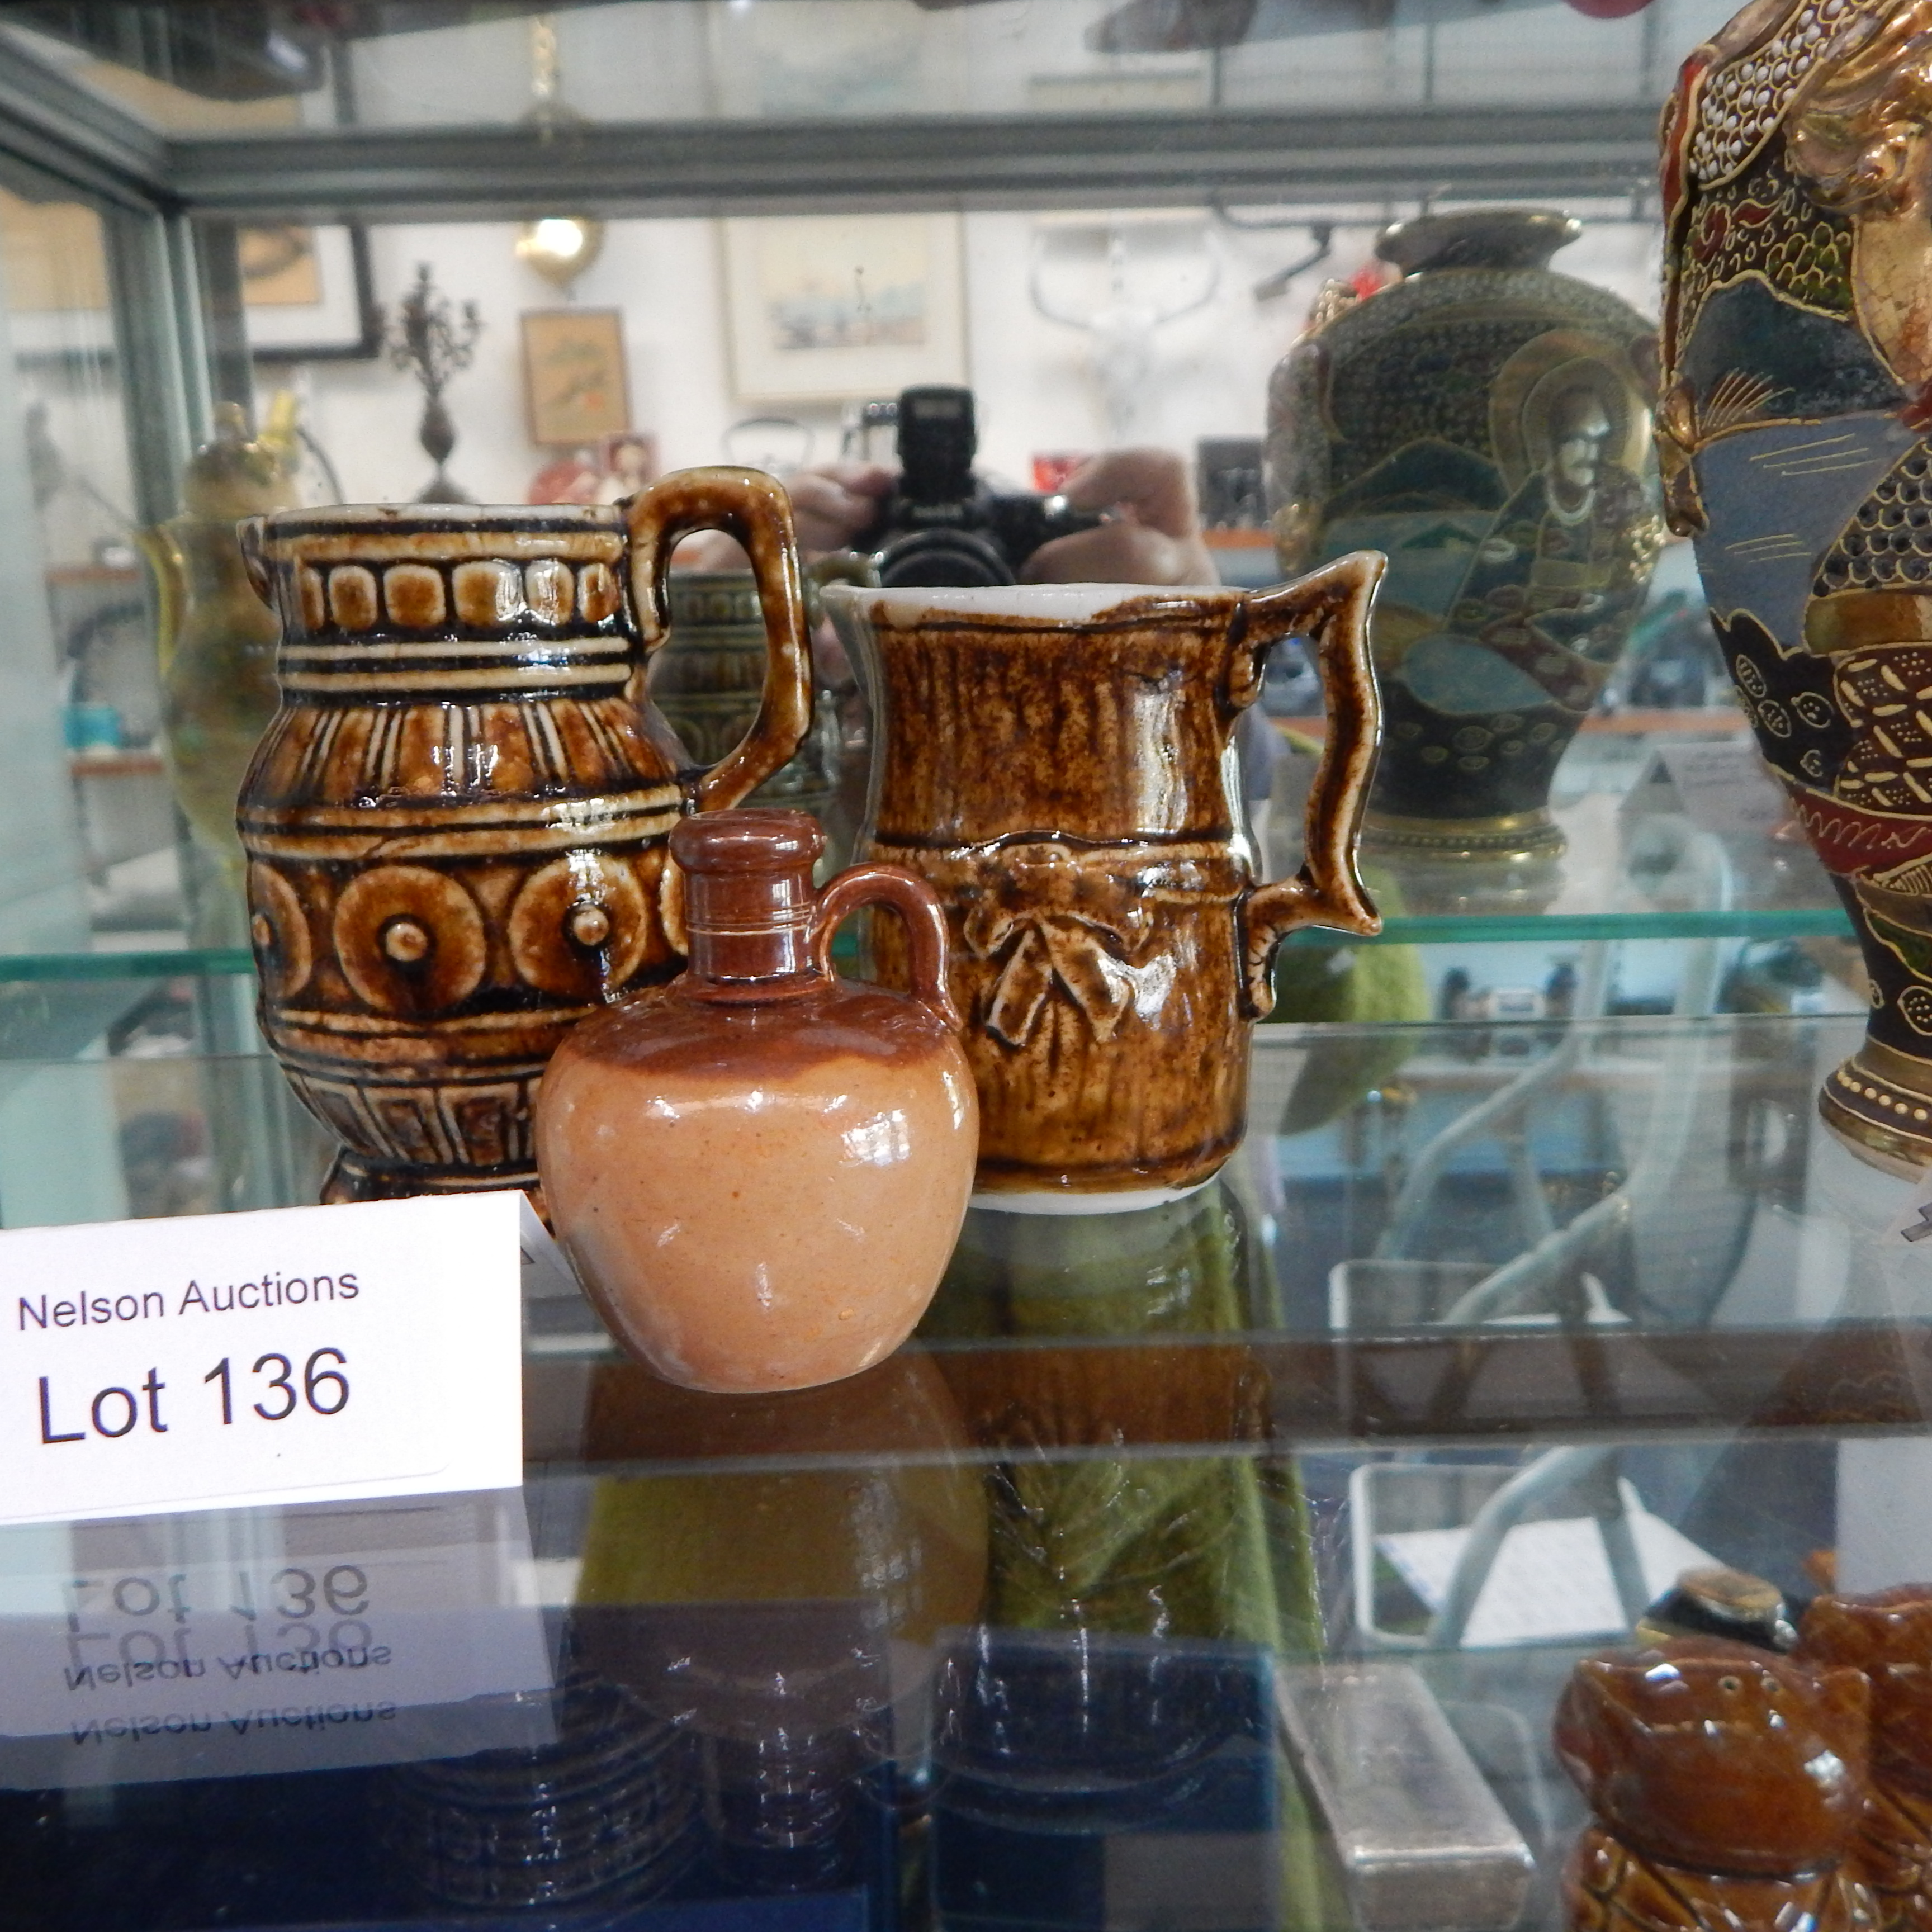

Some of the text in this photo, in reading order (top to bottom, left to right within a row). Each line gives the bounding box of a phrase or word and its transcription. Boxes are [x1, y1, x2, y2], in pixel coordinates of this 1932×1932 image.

[19, 1272, 359, 1331] Nelson Auctions
[39, 1347, 350, 1445] Lot 136
